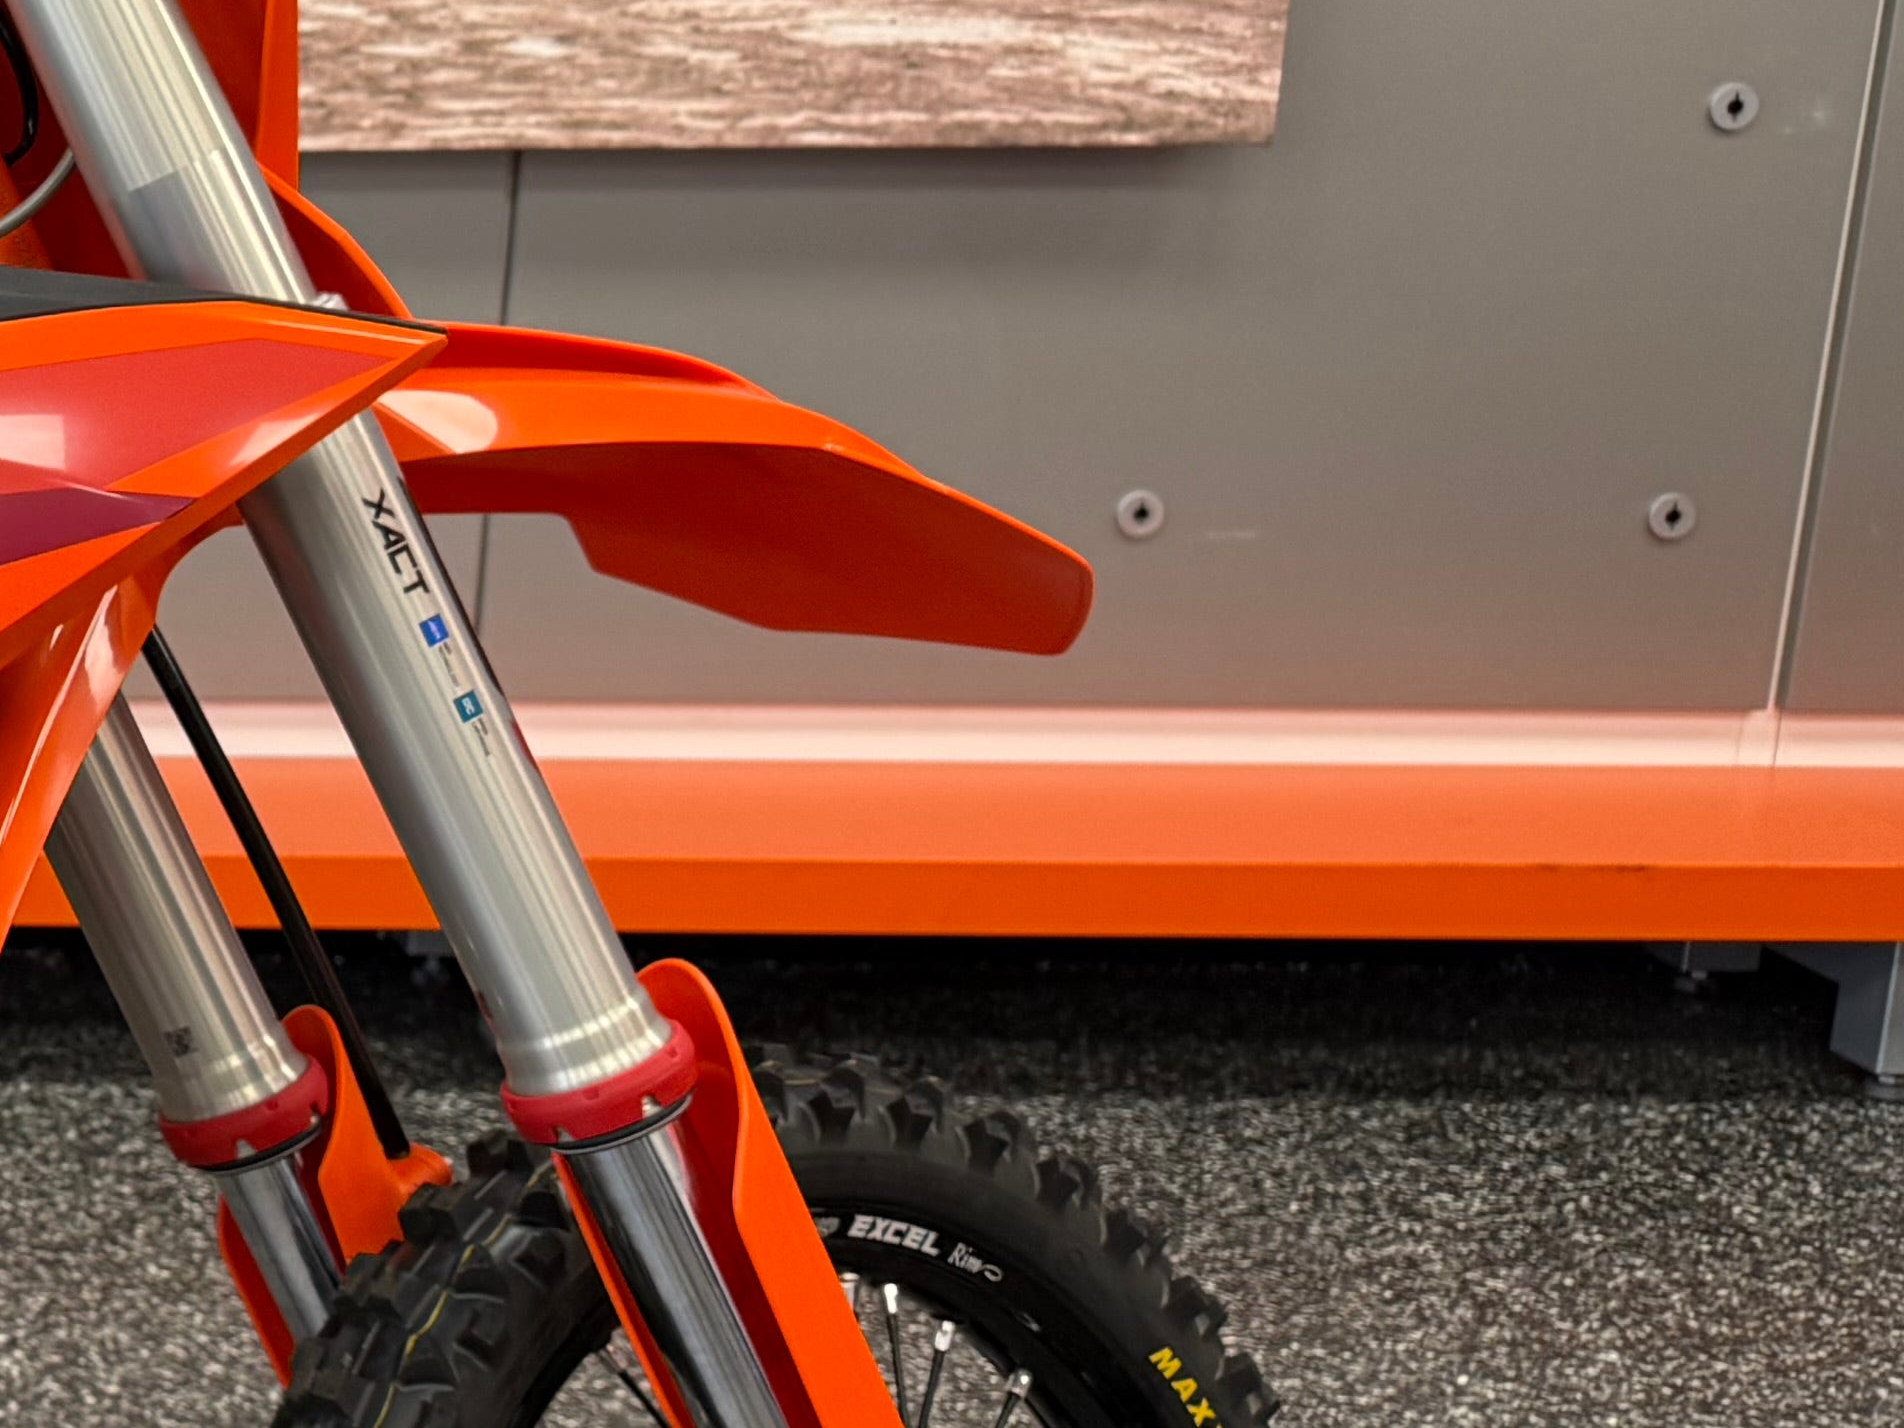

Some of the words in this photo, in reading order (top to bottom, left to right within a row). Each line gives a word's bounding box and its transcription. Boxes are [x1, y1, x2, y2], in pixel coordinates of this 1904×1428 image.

[362, 488, 430, 594] XACT
[847, 1214, 941, 1256] EXCEL
[948, 1241, 1003, 1283] Rim
